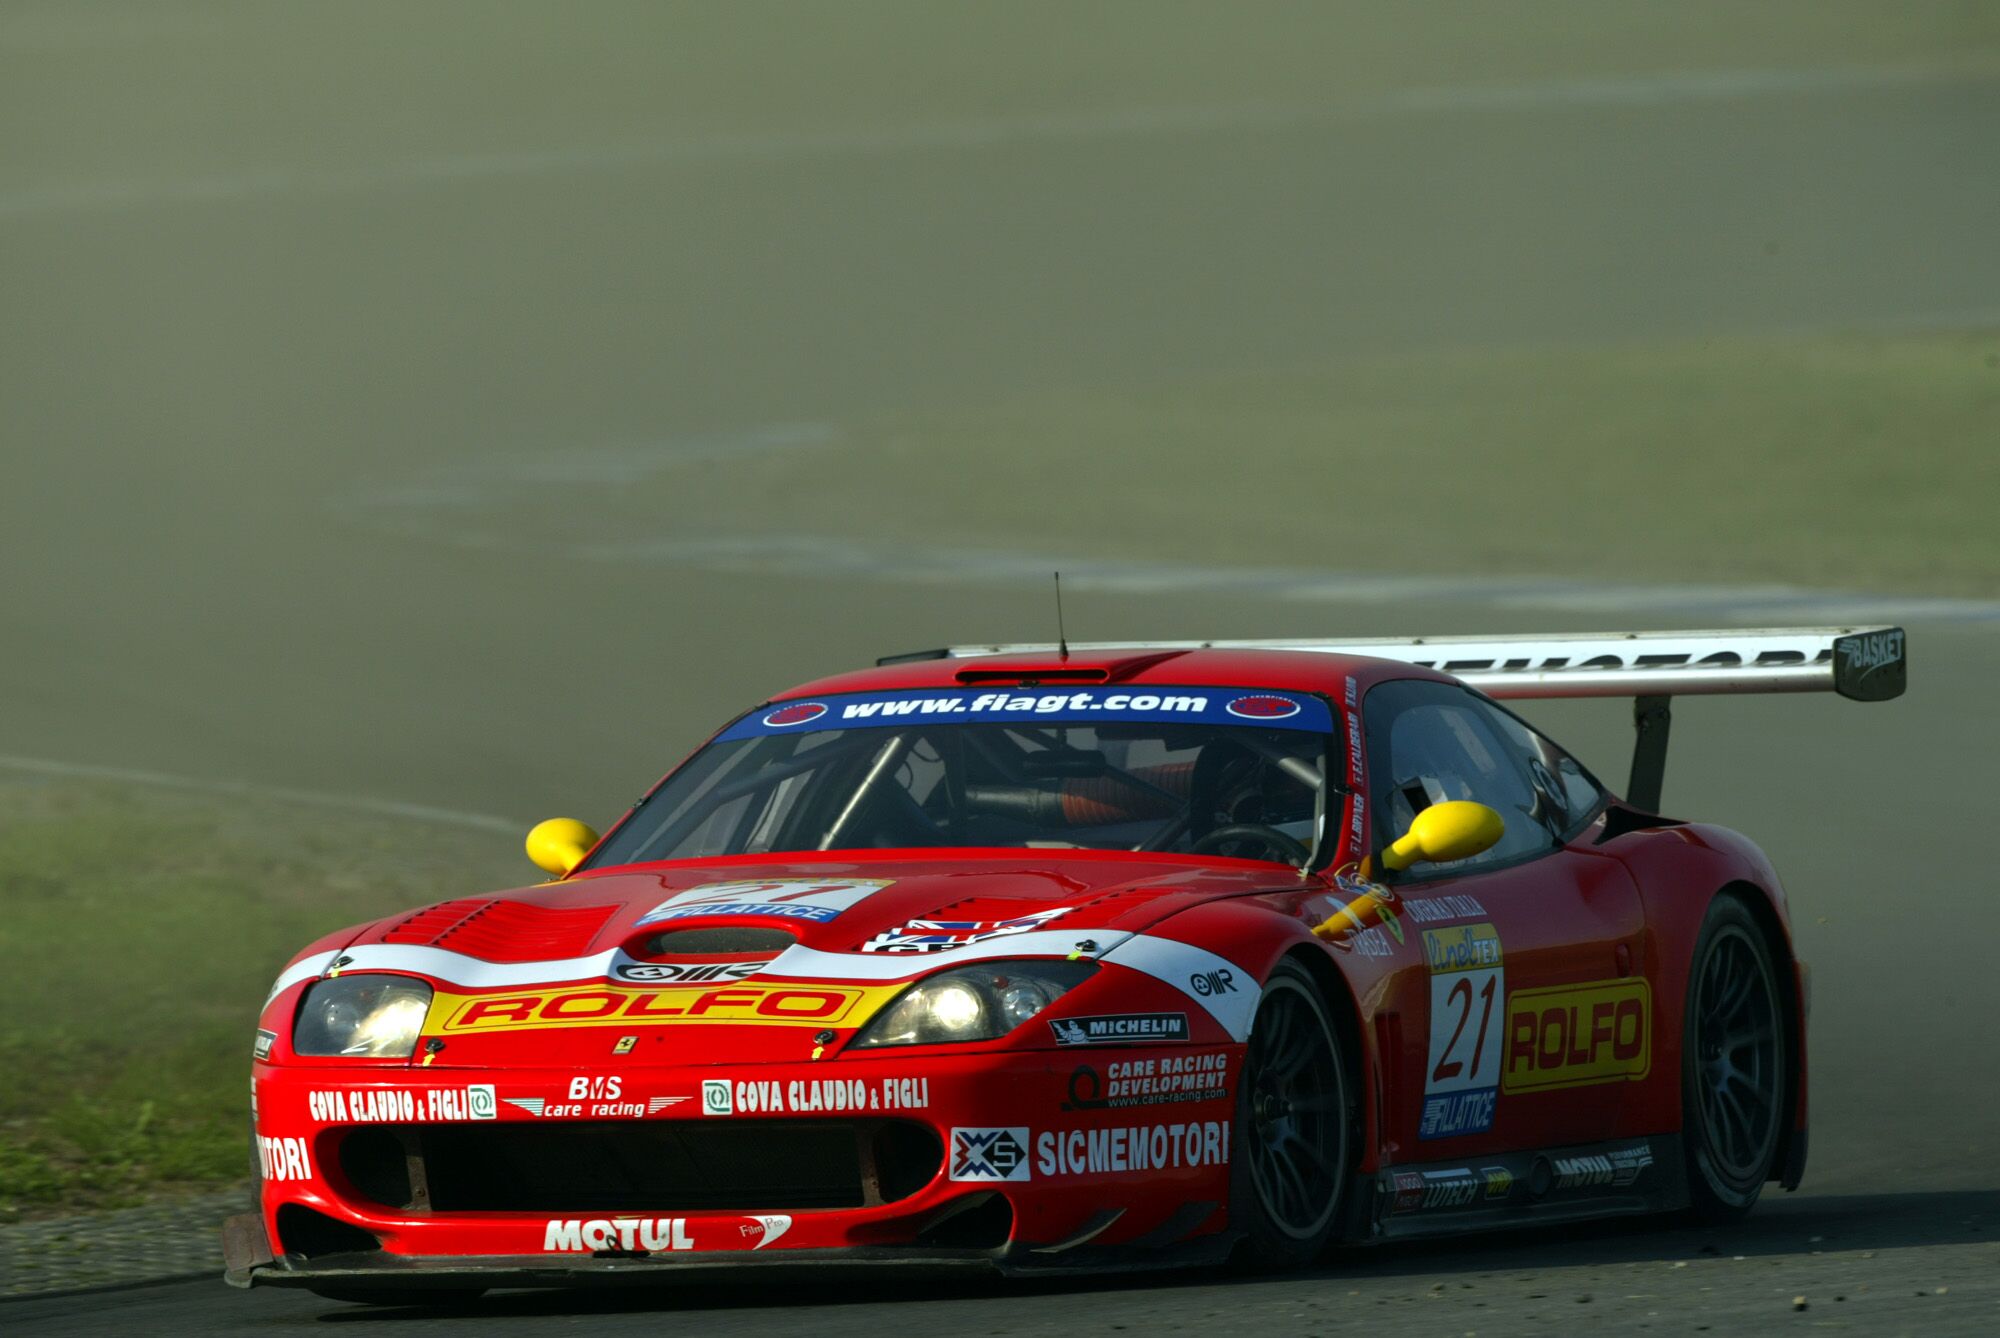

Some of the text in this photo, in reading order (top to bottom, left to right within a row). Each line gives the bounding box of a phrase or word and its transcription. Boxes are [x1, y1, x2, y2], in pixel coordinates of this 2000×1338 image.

[842, 692, 1207, 719] www.fiagt.com
[458, 990, 847, 1025] ROLFO
[1090, 1018, 1181, 1035] MICHELIN
[1432, 973, 1497, 1083] 21
[1508, 997, 1643, 1073] ROLFO
[1108, 1053, 1228, 1080] CARE RACING
[736, 1077, 928, 1113] COVA CLAUDIO & FIGLI
[1108, 1071, 1226, 1098] DEVELOPMENT
[1108, 1087, 1226, 1108] www.care-racing.com
[308, 1088, 468, 1122] COVA CLAUDIO & FIGLI
[544, 1101, 646, 1118] care racing
[1036, 1120, 1230, 1177] SICMEMOTORI
[544, 1216, 695, 1251] MOTUL
[738, 1224, 764, 1238] Film
